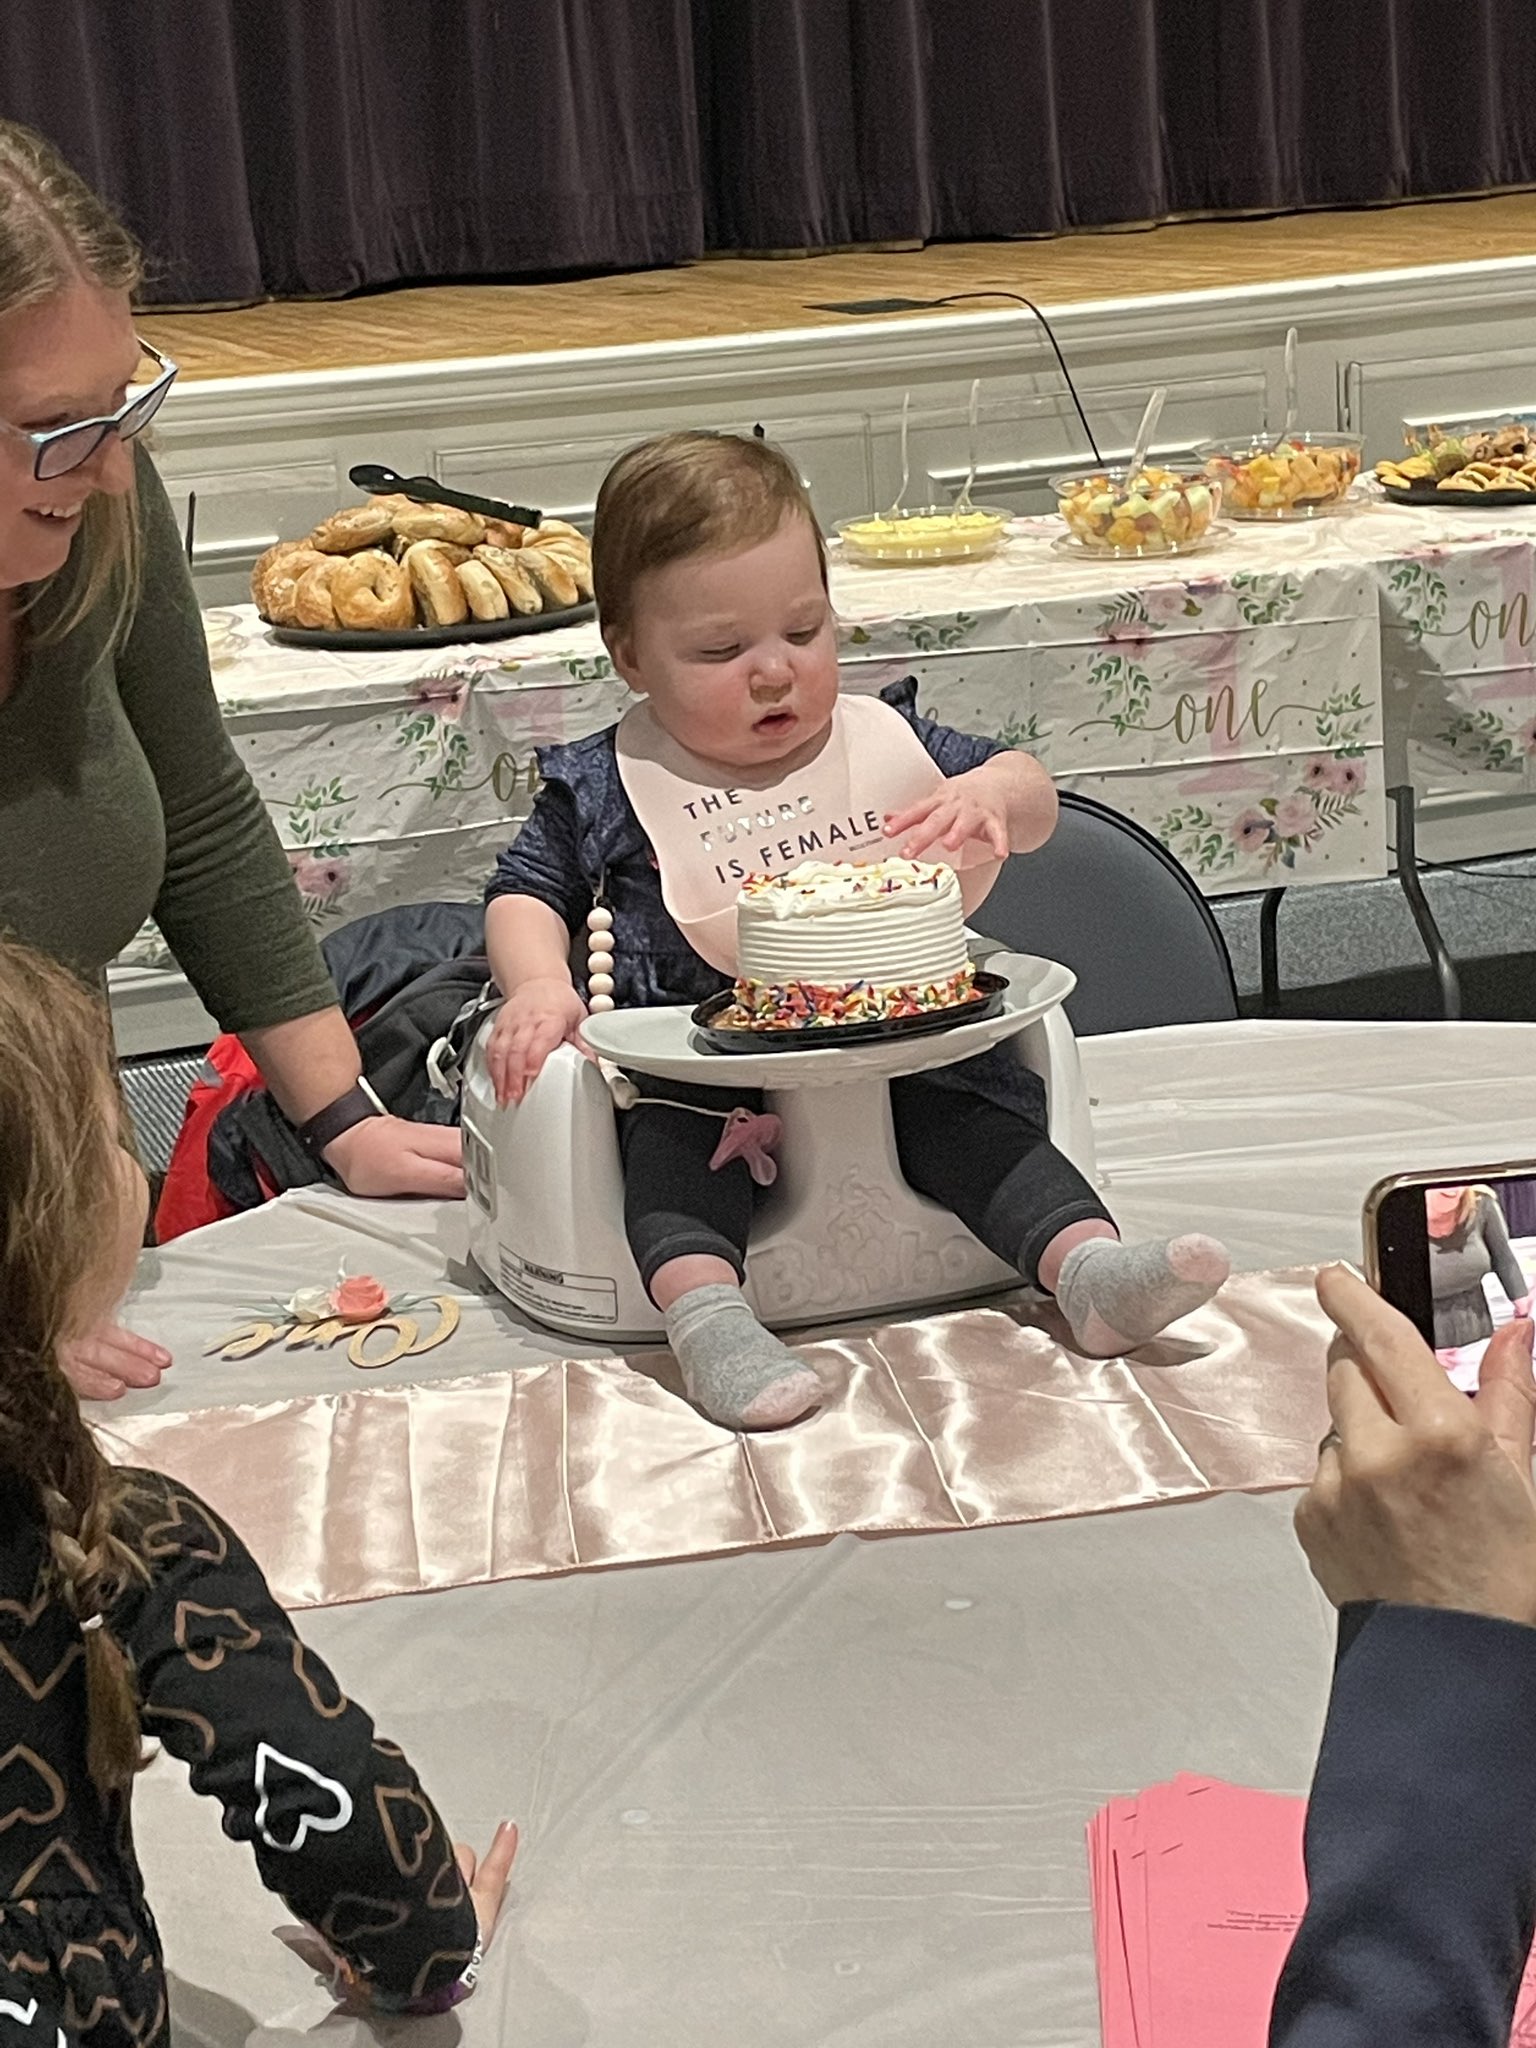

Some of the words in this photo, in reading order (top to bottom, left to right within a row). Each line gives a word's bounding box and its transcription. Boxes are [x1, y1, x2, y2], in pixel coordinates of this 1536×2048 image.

[1469, 591, 1536, 650] on
[683, 788, 742, 820] THE
[700, 795, 815, 852] FUTURE
[715, 859, 745, 884] IS
[759, 810, 880, 867] FEMALE
